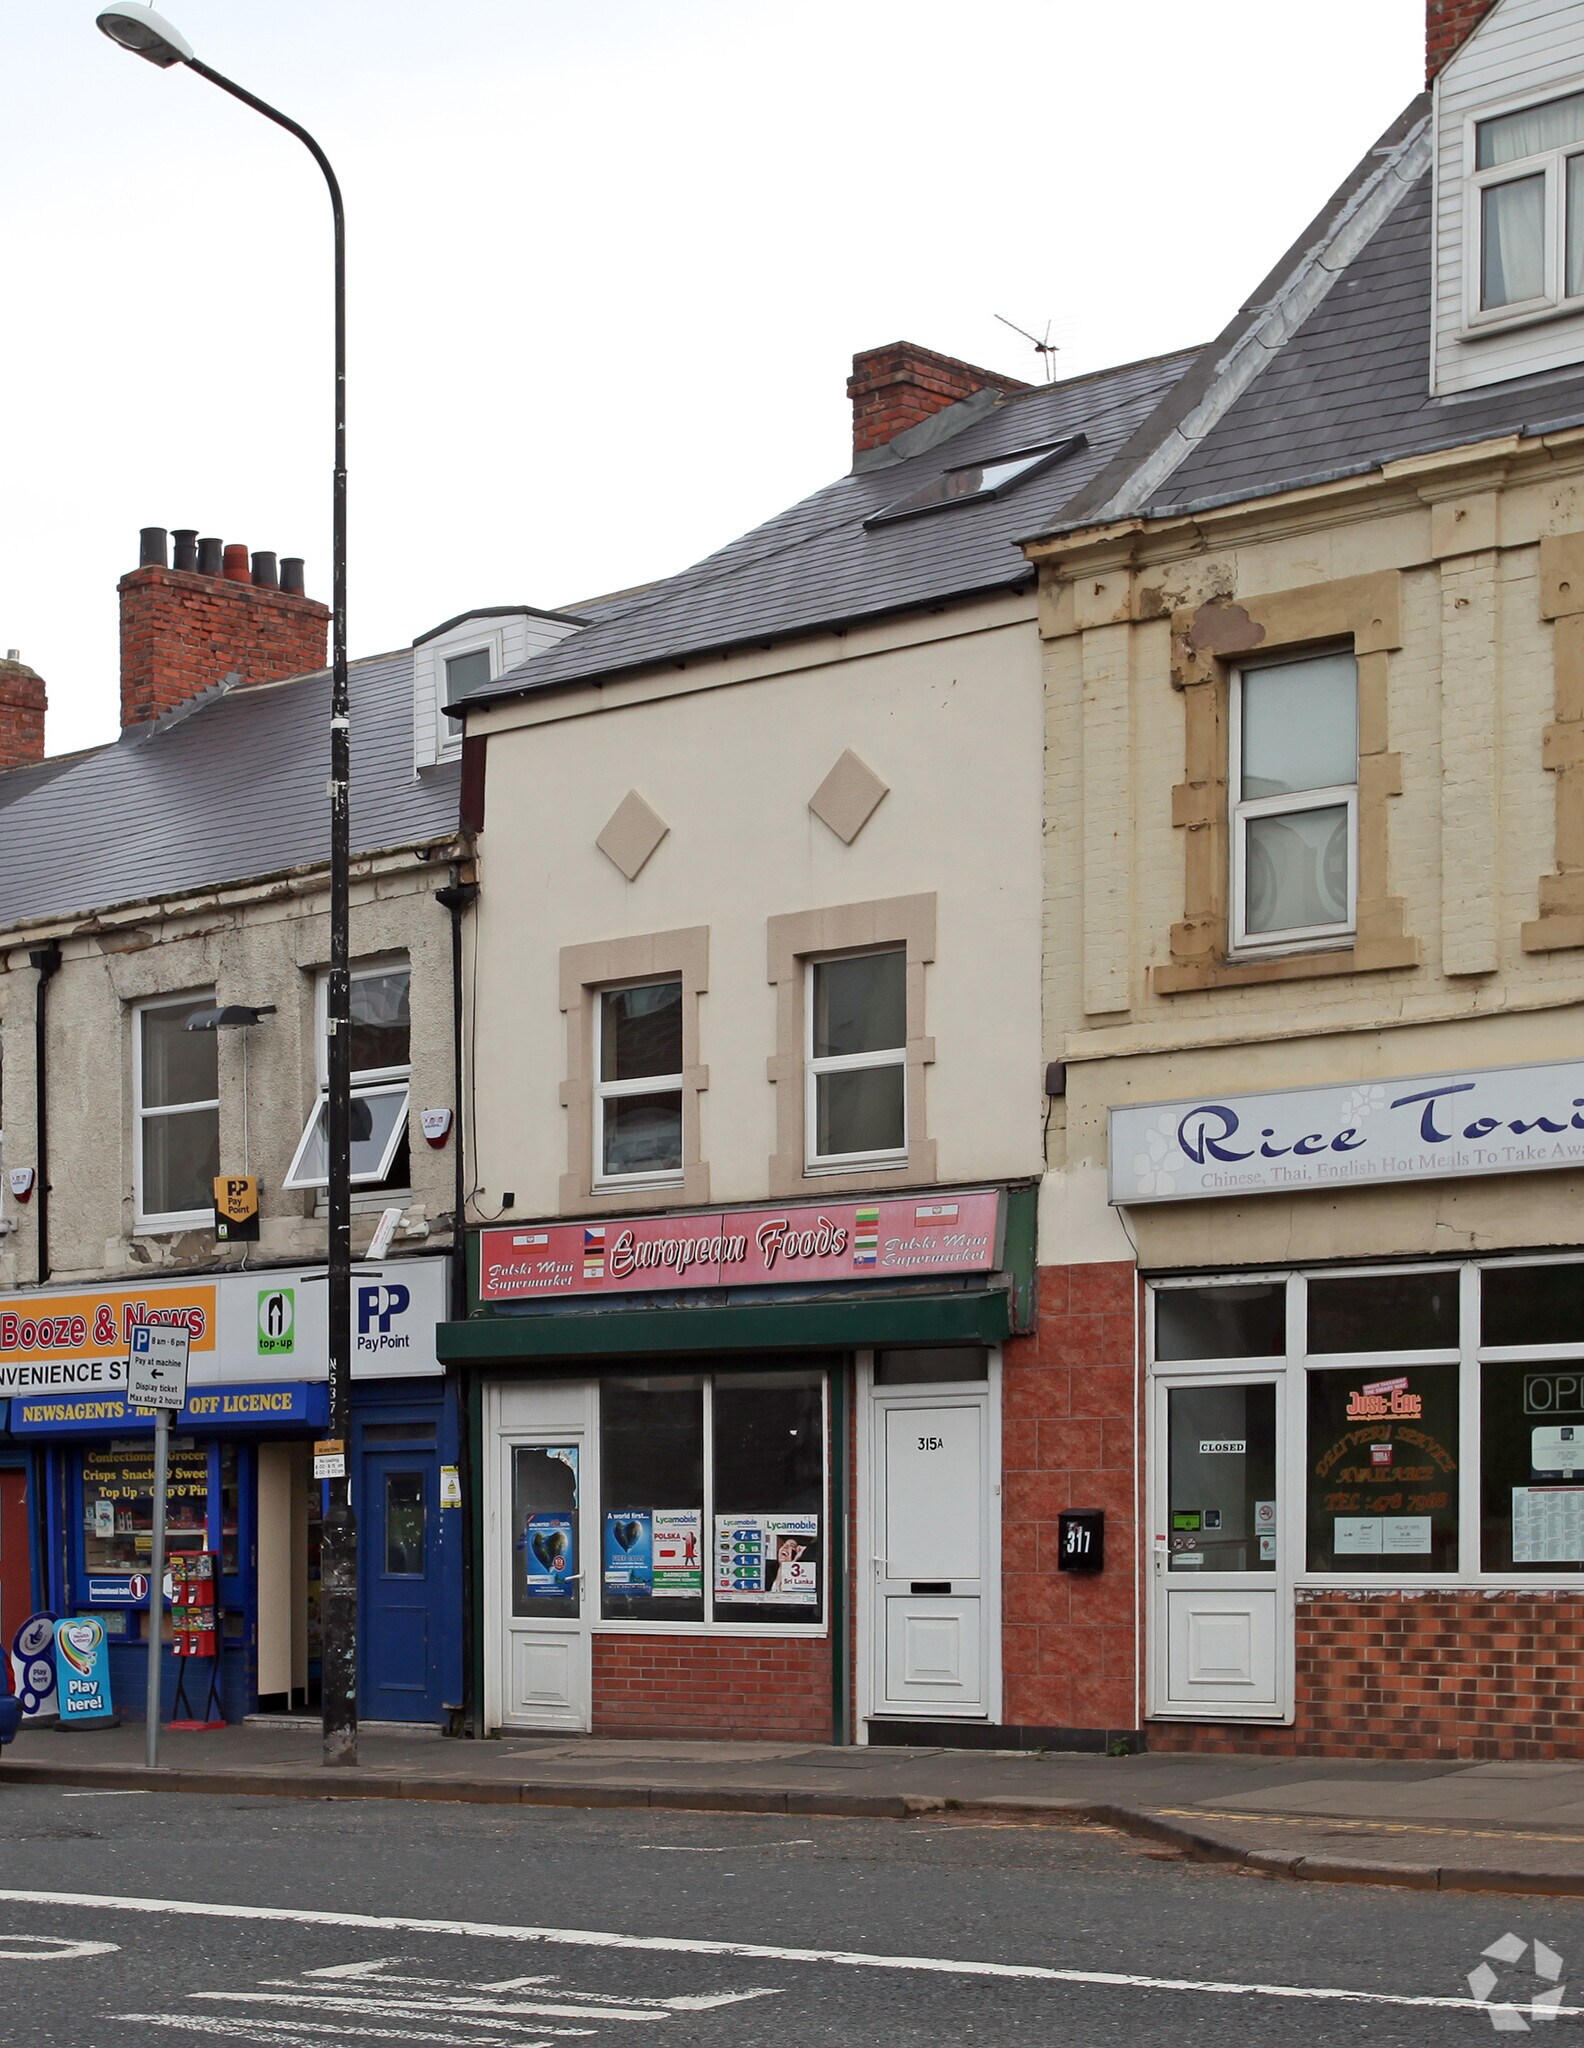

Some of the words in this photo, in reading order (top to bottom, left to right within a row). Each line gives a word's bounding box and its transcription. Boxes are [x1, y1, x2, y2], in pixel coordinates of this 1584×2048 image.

[1177, 1105, 1367, 1165] Rice
[1201, 1171, 1267, 1188] Chinese,
[1270, 1164, 1312, 1181] Thai,
[1317, 1158, 1376, 1179] English
[1382, 1156, 1414, 1171] Hot
[1418, 1151, 1470, 1169] Meals
[1473, 1149, 1498, 1165] To
[1502, 1145, 1547, 1161] Take
[228, 1198, 243, 1207] Pay
[228, 1205, 250, 1214] Point
[609, 1229, 748, 1279] European
[756, 1215, 848, 1269] Foods
[884, 1237, 938, 1251] Polski
[942, 1232, 988, 1246] Mini
[881, 1249, 987, 1267] Supermarket
[487, 1261, 532, 1277] Polski
[536, 1260, 575, 1273] Mini
[486, 1275, 573, 1291] Supermarket
[1, 1312, 87, 1351] Booze
[93, 1304, 118, 1346] &
[137, 1330, 148, 1350] P
[151, 1337, 156, 1345] 8
[171, 1337, 175, 1346] 6
[135, 1356, 146, 1366] Pay
[156, 1358, 181, 1368] machine
[136, 1381, 158, 1393] Display
[160, 1383, 178, 1393] ticket
[1529, 1376, 1584, 1411] OP
[130, 1393, 142, 1402] Max
[144, 1394, 157, 1405] stay
[159, 1395, 164, 1404] 2
[165, 1396, 182, 1406] hours
[23, 1401, 124, 1423] NEWSAGENTS
[189, 1396, 220, 1415] OFF
[223, 1392, 293, 1413] LICENCE
[918, 1437, 944, 1450] 315A
[1201, 1443, 1244, 1452] CLOSED
[83, 1469, 116, 1482] Crisps
[122, 1468, 155, 1480] Snack
[99, 1486, 120, 1499] Top
[122, 1486, 138, 1499] Up
[189, 1484, 208, 1496] Pin
[656, 1515, 697, 1525] Lycamobile
[767, 1520, 816, 1531] Lycamobile
[1067, 1525, 1090, 1553] 317
[33, 1668, 46, 1678] Play
[33, 1676, 48, 1684] here
[69, 1680, 99, 1694] Play
[67, 1695, 104, 1711] here!
